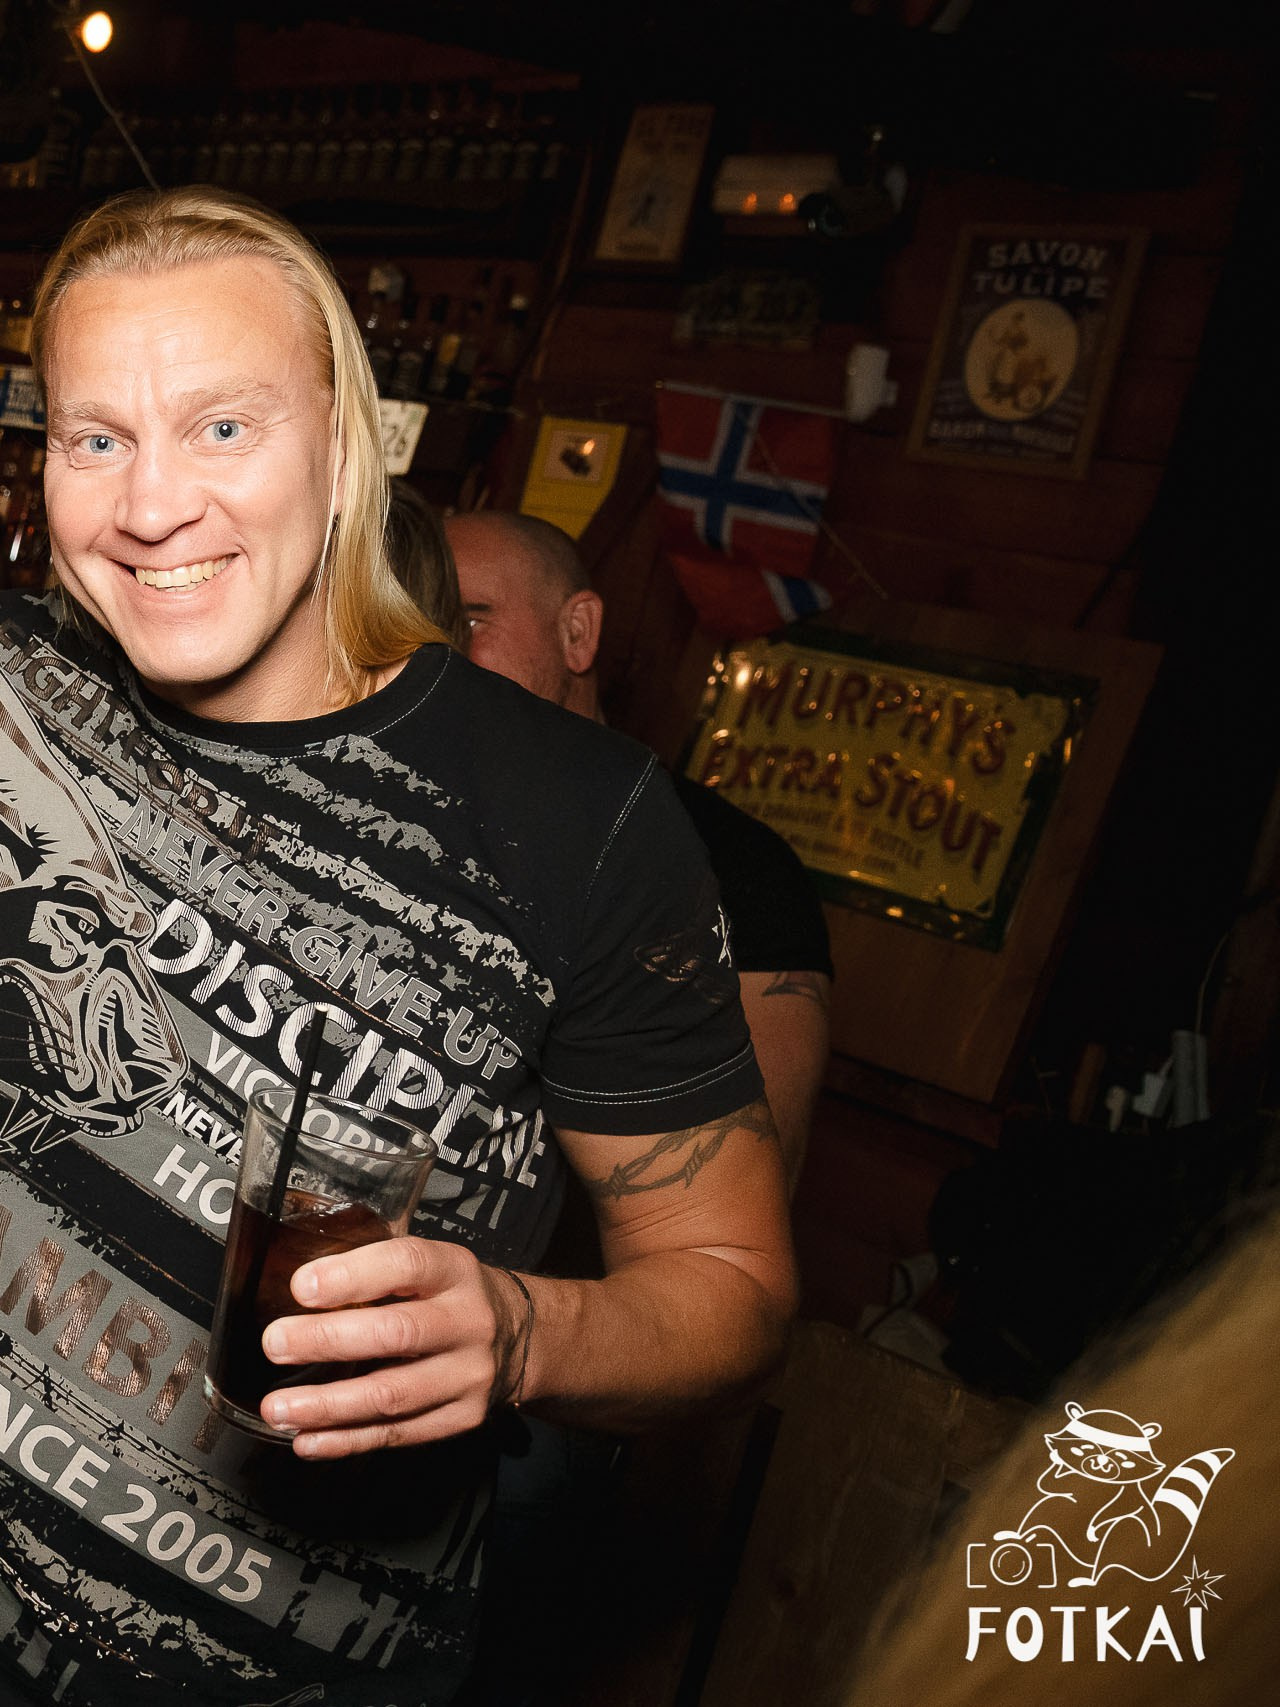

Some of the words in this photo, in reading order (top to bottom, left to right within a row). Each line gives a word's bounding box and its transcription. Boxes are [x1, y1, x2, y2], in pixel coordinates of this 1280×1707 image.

[972, 270, 1110, 299] TULIPE
[987, 240, 1109, 272] SAVON
[703, 737, 843, 798] EXTRA
[853, 752, 1002, 874] STOUT
[116, 795, 289, 945] NEVER
[290, 926, 442, 1038] GIVE
[443, 1005, 522, 1080] UP
[164, 1090, 242, 1167] NEVE
[101, 1483, 272, 1602] 2005
